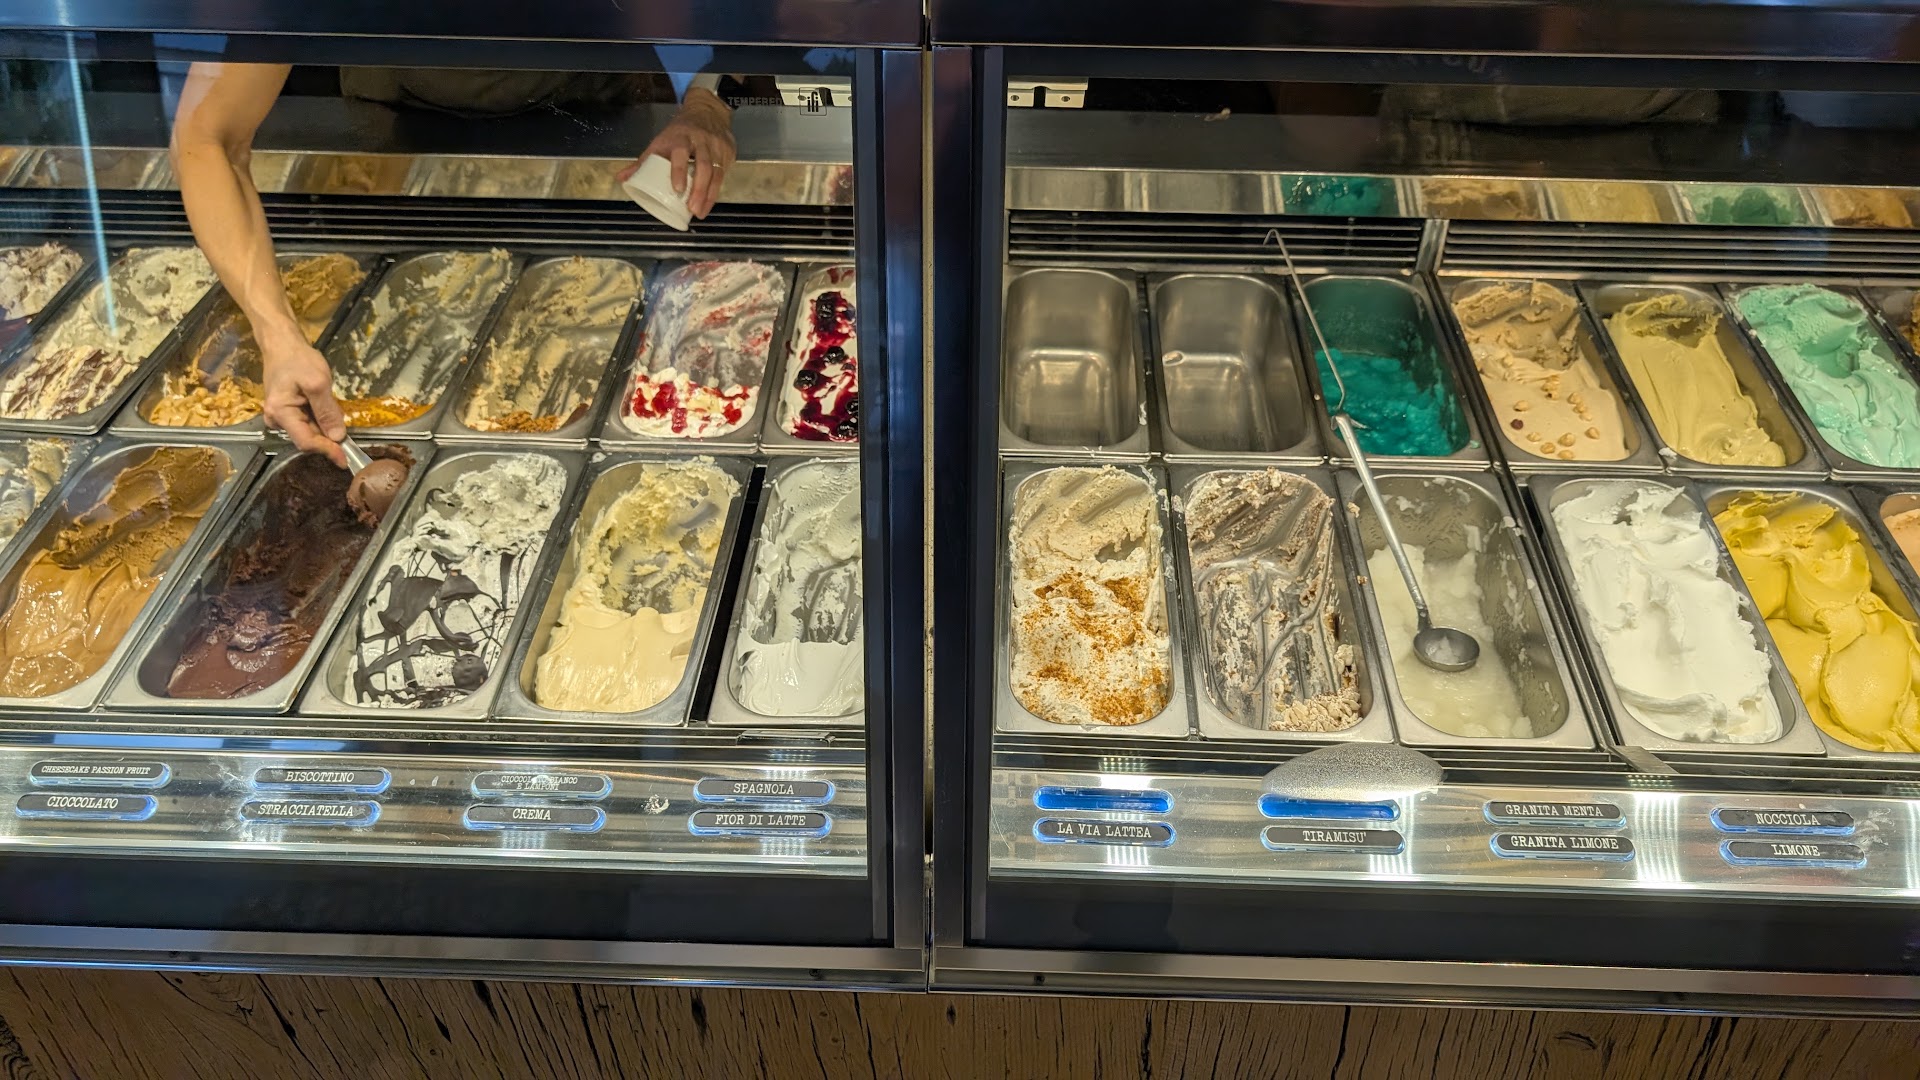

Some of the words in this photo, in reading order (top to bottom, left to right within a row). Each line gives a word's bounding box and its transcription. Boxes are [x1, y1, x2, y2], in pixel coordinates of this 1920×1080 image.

[41, 765, 90, 774] CHEESECAKE
[91, 766, 124, 775] PASSION
[125, 767, 151, 775] FRUIT
[284, 771, 355, 783] BISCOTTINO
[501, 775, 547, 783] CIOCCOLTO
[549, 776, 578, 784] BIANCO
[733, 782, 795, 795] SPAGNOLA
[46, 796, 119, 809] CIOCCOLATO
[258, 802, 354, 817] STRACCIATELLA
[512, 808, 552, 820] CREMA
[1505, 804, 1560, 816] GRANITA
[1563, 805, 1604, 817] MENTA
[715, 814, 745, 826] FIOR
[748, 814, 765, 826] DI
[767, 814, 806, 826] LATTE
[1755, 812, 1821, 826] NOCCIOLA
[1057, 823, 1074, 835] LA
[1077, 823, 1101, 836] VIA
[1104, 825, 1152, 838] LATTEA
[1302, 830, 1367, 843] TIRAMISU'
[1510, 836, 1567, 848] GRANITA
[1569, 837, 1619, 850] LIMONE
[1772, 844, 1821, 857] LIMONE
